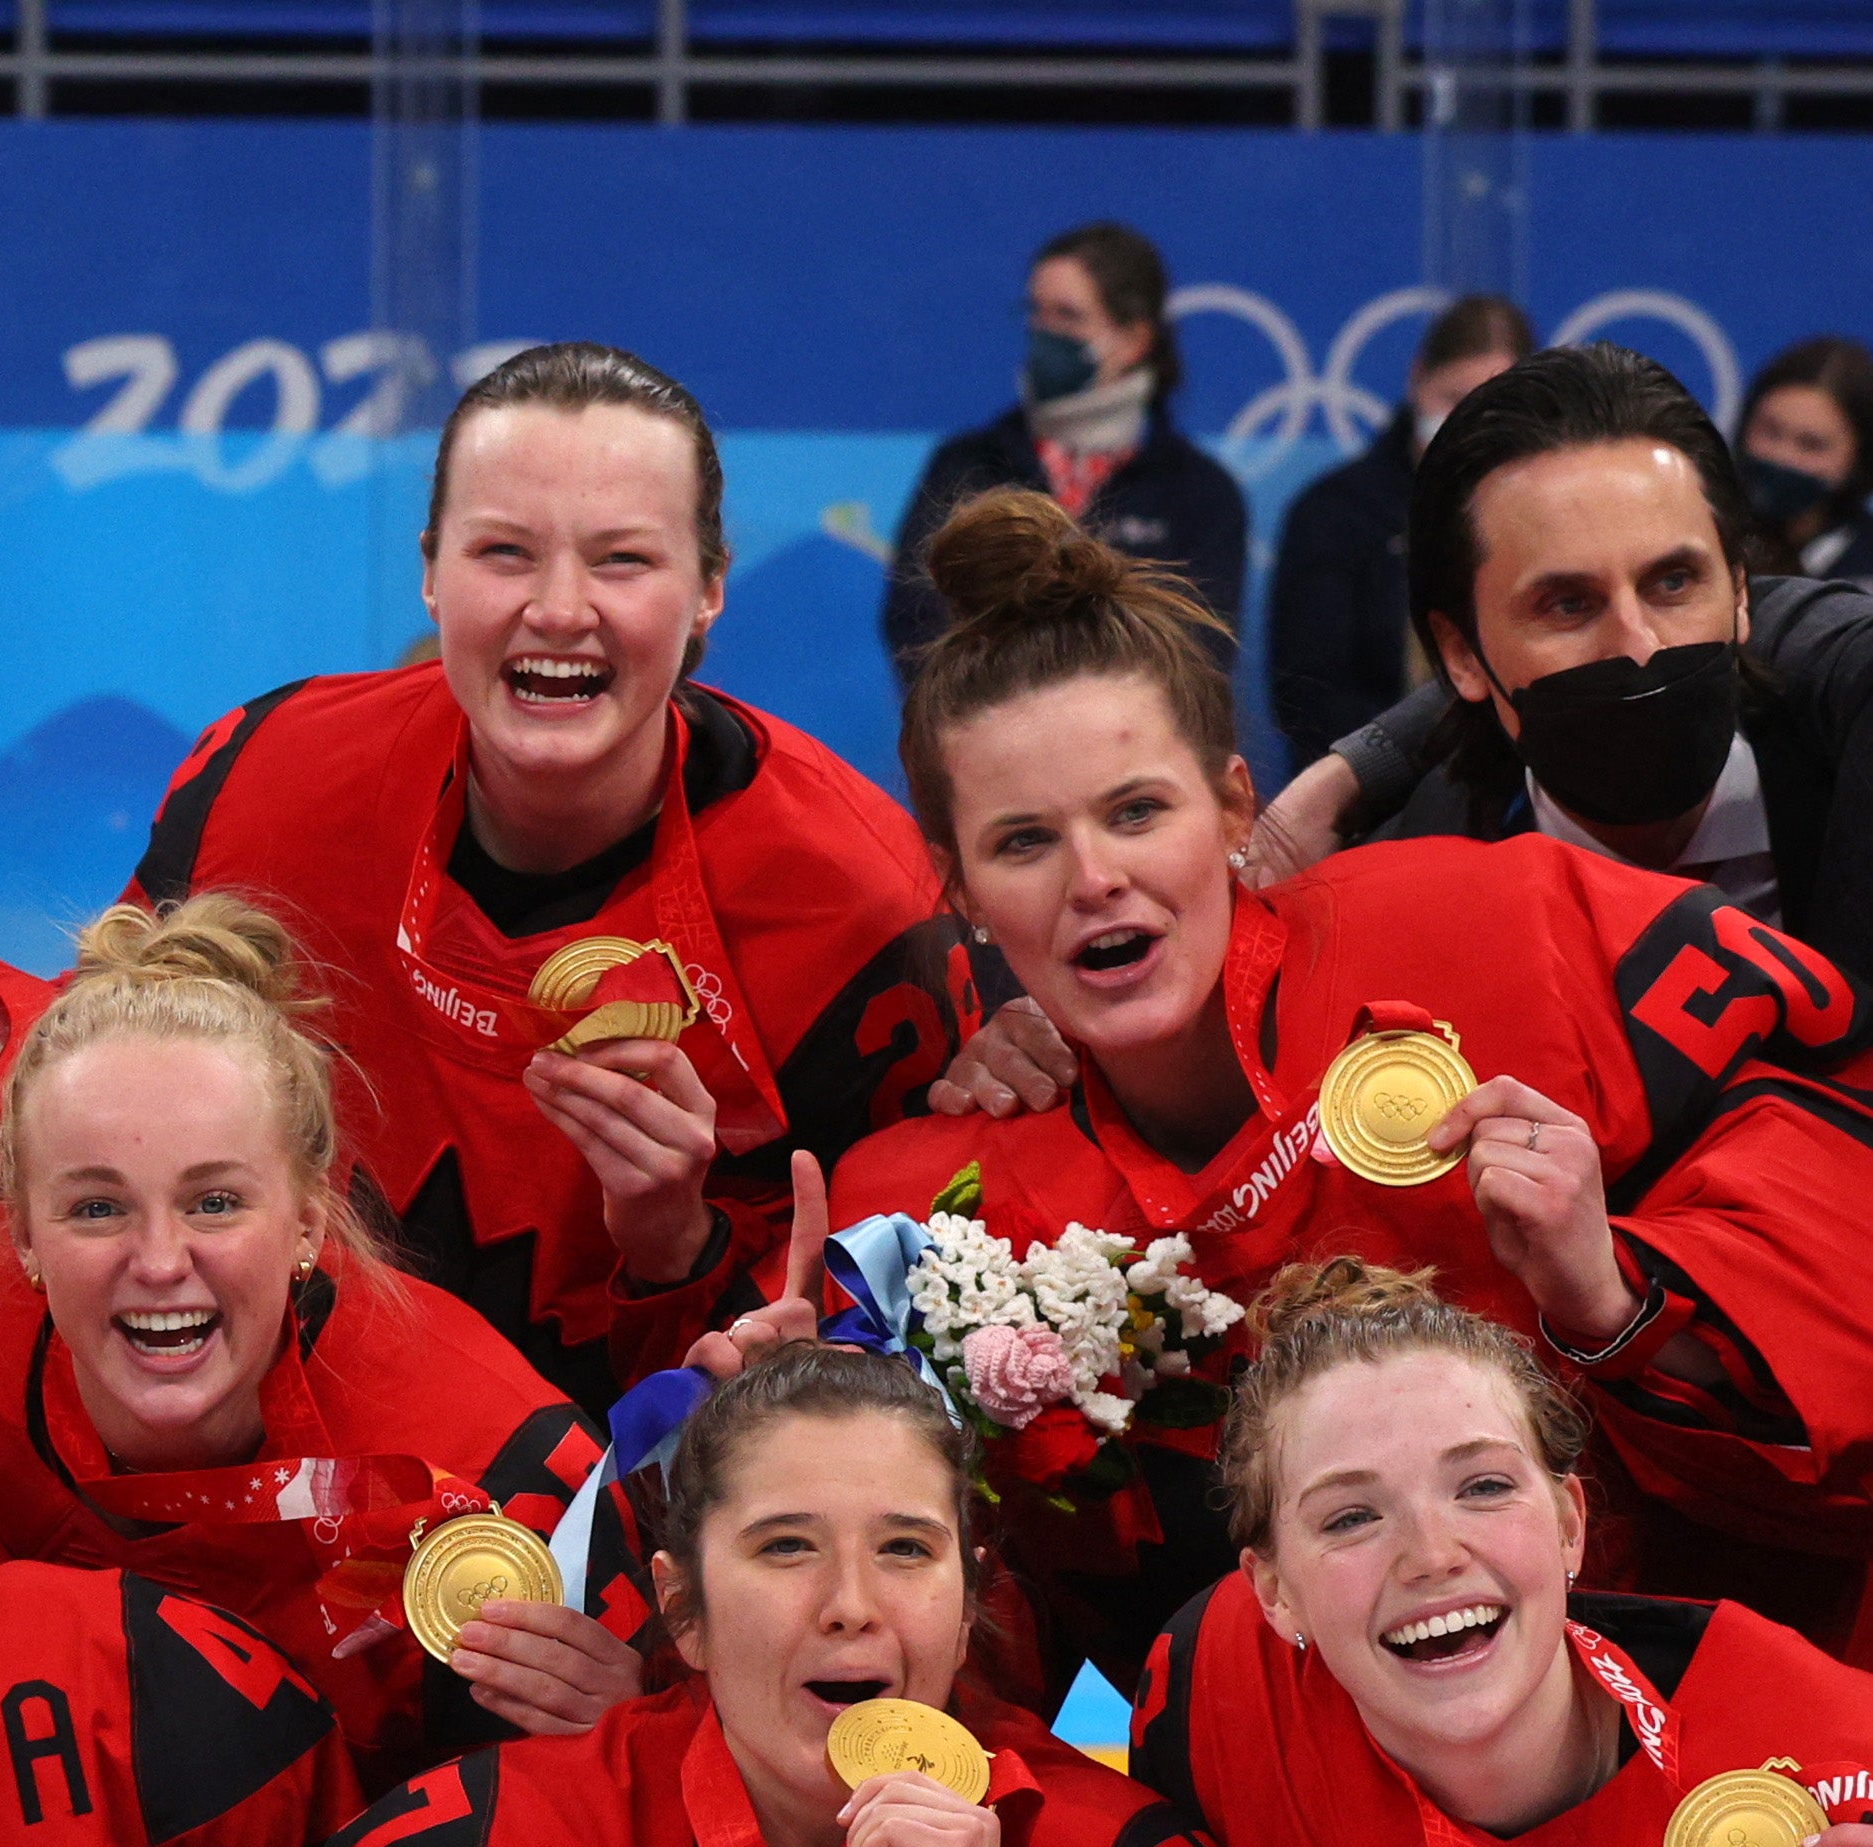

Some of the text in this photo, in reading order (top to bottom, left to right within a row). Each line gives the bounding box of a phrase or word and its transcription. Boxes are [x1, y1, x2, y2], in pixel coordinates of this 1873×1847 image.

[52, 332, 544, 496] 202
[412, 968, 499, 1037] BEIJING
[1629, 905, 1854, 1081] 50
[0, 1678, 94, 1827] A
[1589, 1652, 1655, 1706] 2022
